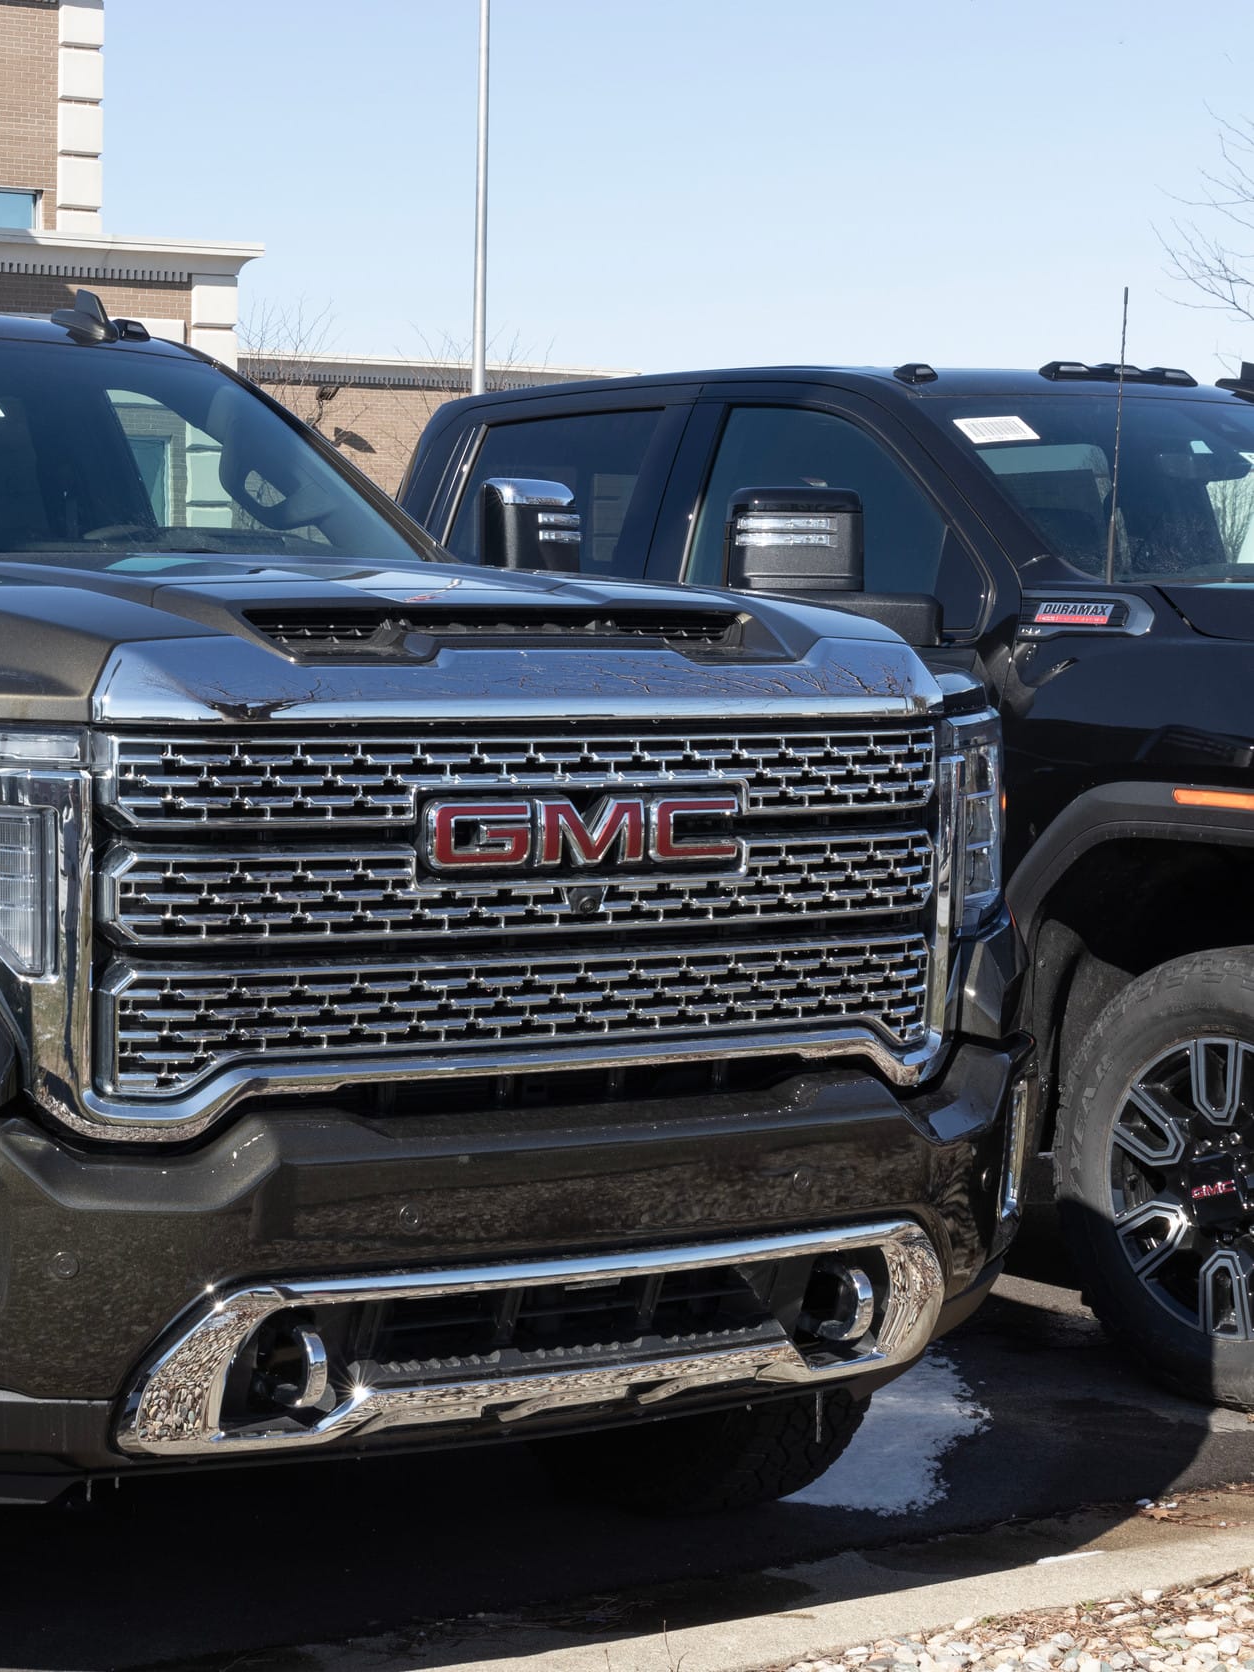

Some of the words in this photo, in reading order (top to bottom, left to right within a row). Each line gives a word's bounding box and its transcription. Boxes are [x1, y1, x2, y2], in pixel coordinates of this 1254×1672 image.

[1042, 603, 1109, 616] DURAMAX
[426, 797, 739, 870] GMC
[1191, 1179, 1237, 1199] GMC
